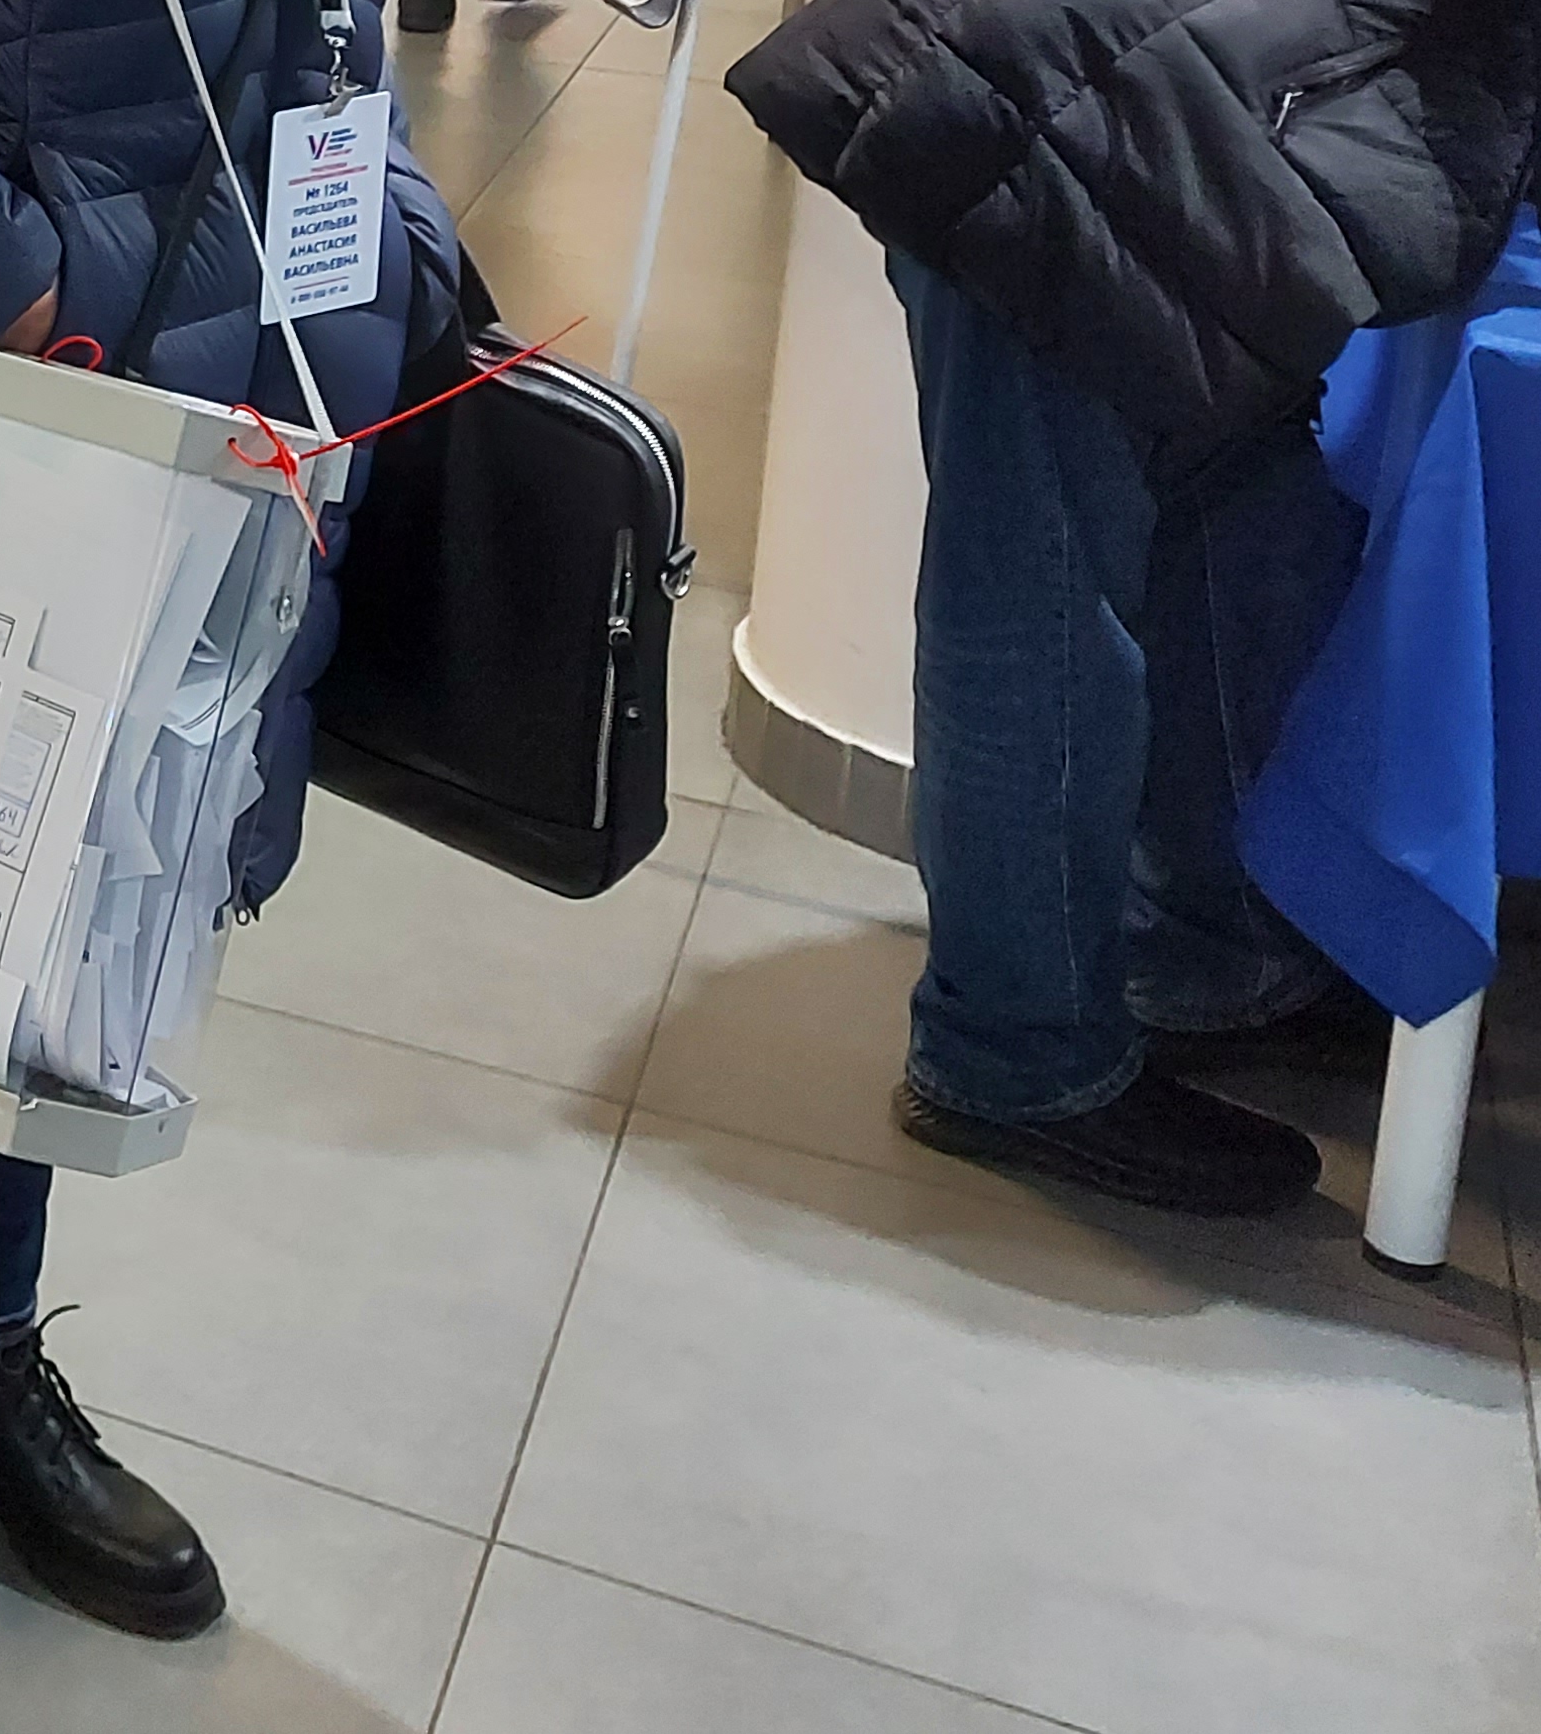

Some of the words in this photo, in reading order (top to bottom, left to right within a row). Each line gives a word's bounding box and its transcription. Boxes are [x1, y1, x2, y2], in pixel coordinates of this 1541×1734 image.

[290, 214, 358, 240] ВАСИЛЬЕВА
[288, 233, 358, 260] АНАСТАСИЯ
[283, 253, 359, 281] ВАСИЛЬЕВНА
